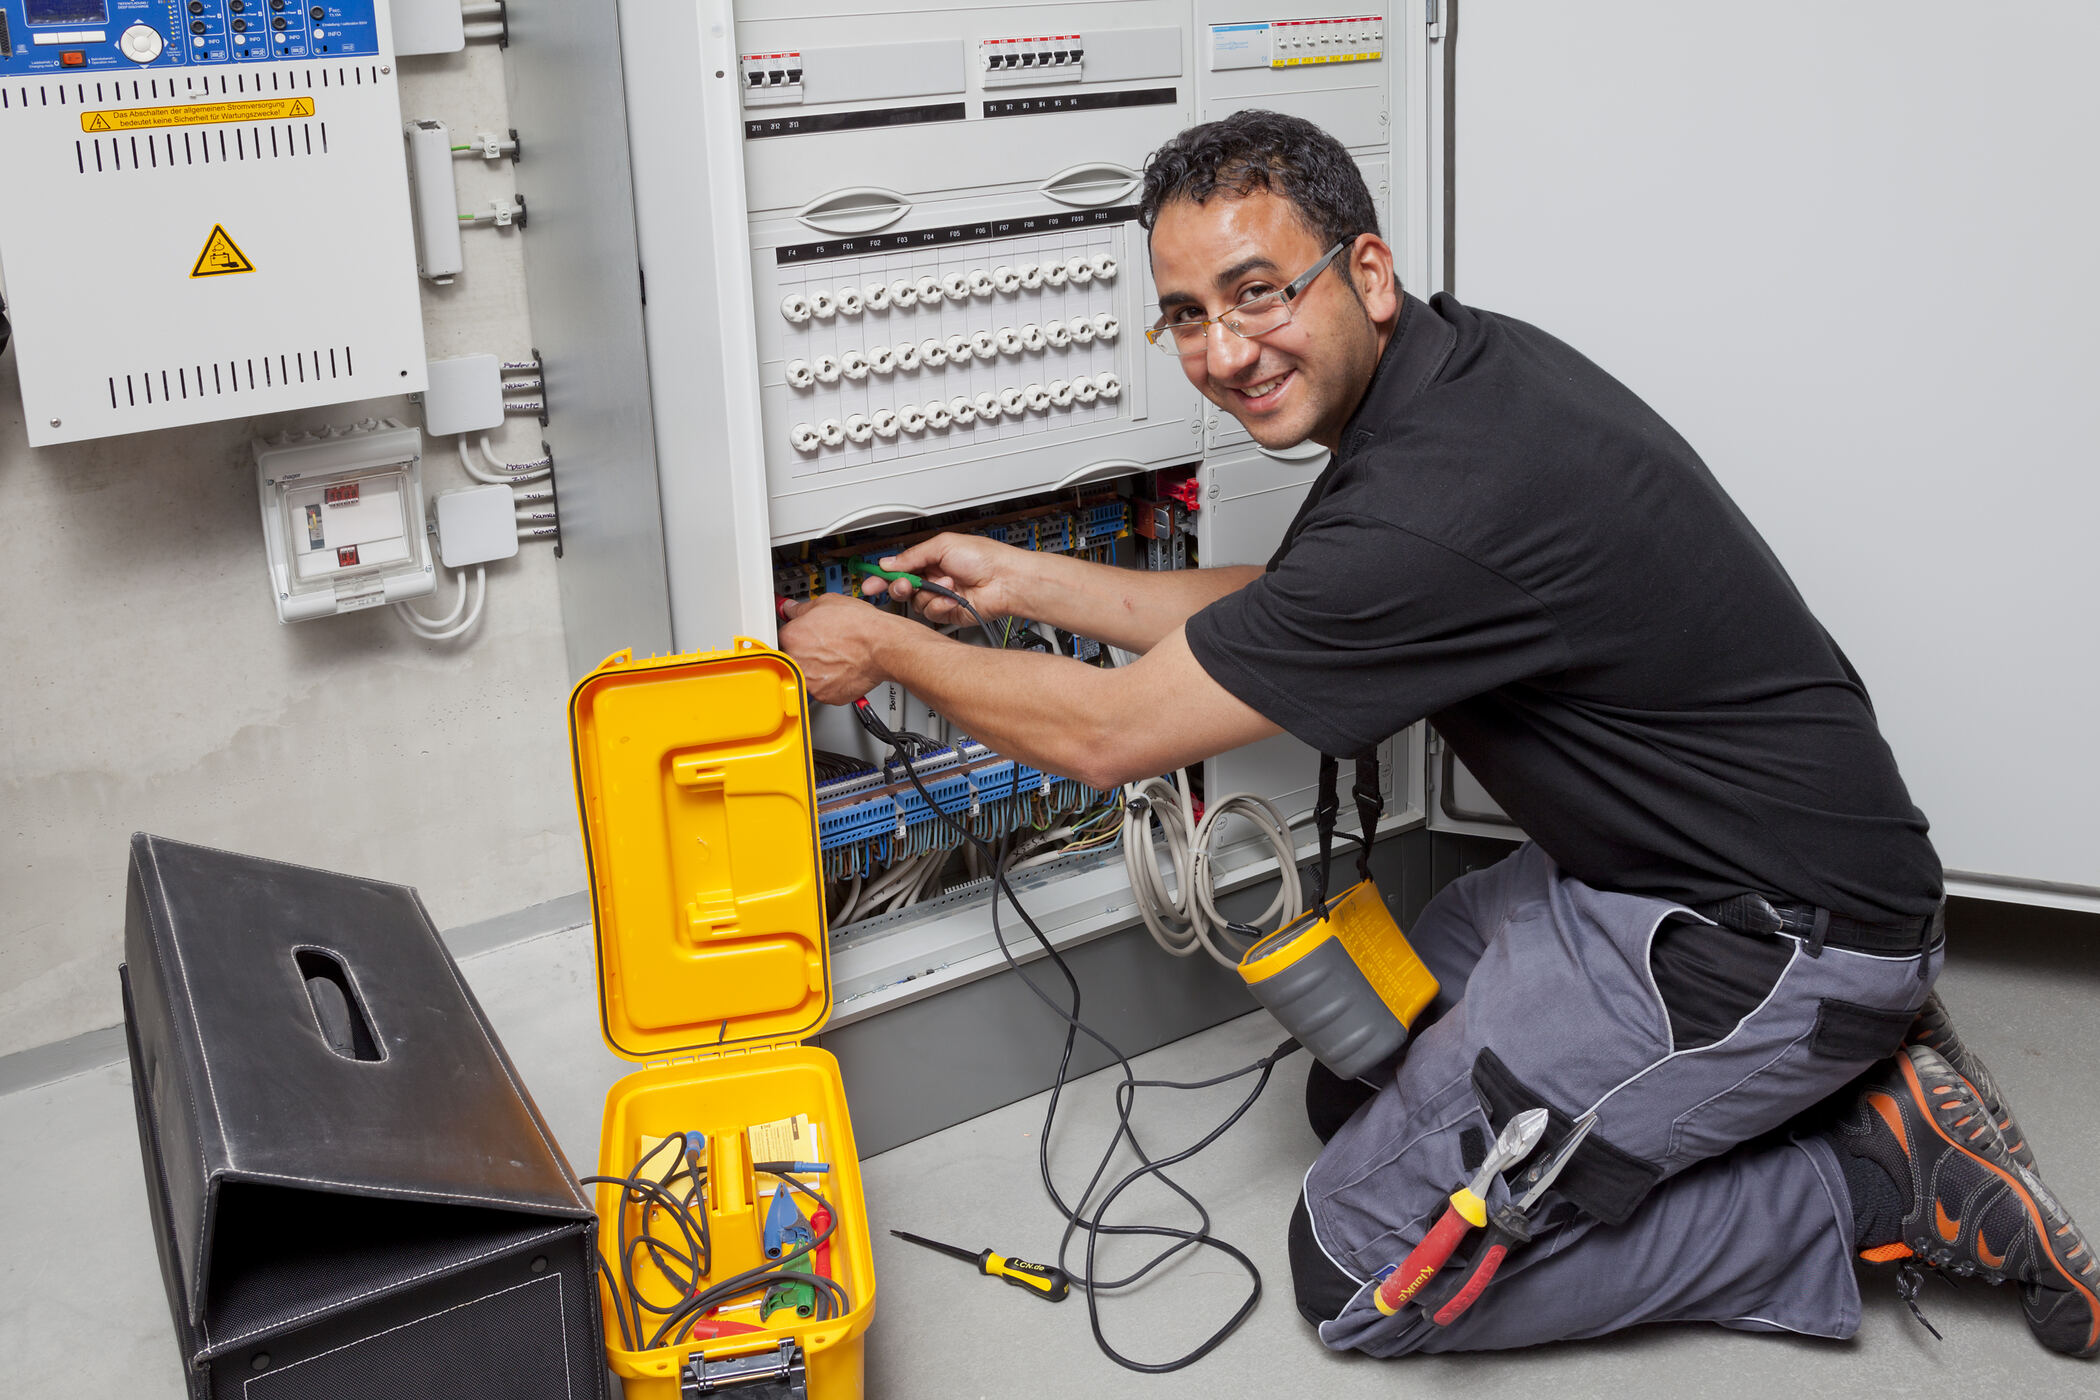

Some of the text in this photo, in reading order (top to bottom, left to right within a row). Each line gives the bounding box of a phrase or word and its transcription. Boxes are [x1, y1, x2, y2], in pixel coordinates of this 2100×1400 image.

[130, 108, 168, 117] Abschalten
[184, 105, 225, 114] allgemeinen
[228, 102, 285, 111] Stromversorgung
[174, 114, 209, 123] Sicherheit
[222, 109, 281, 120] Wartungszwecke!
[1014, 1259, 1044, 1270] LCN.de
[1398, 1265, 1434, 1301] Klauke
